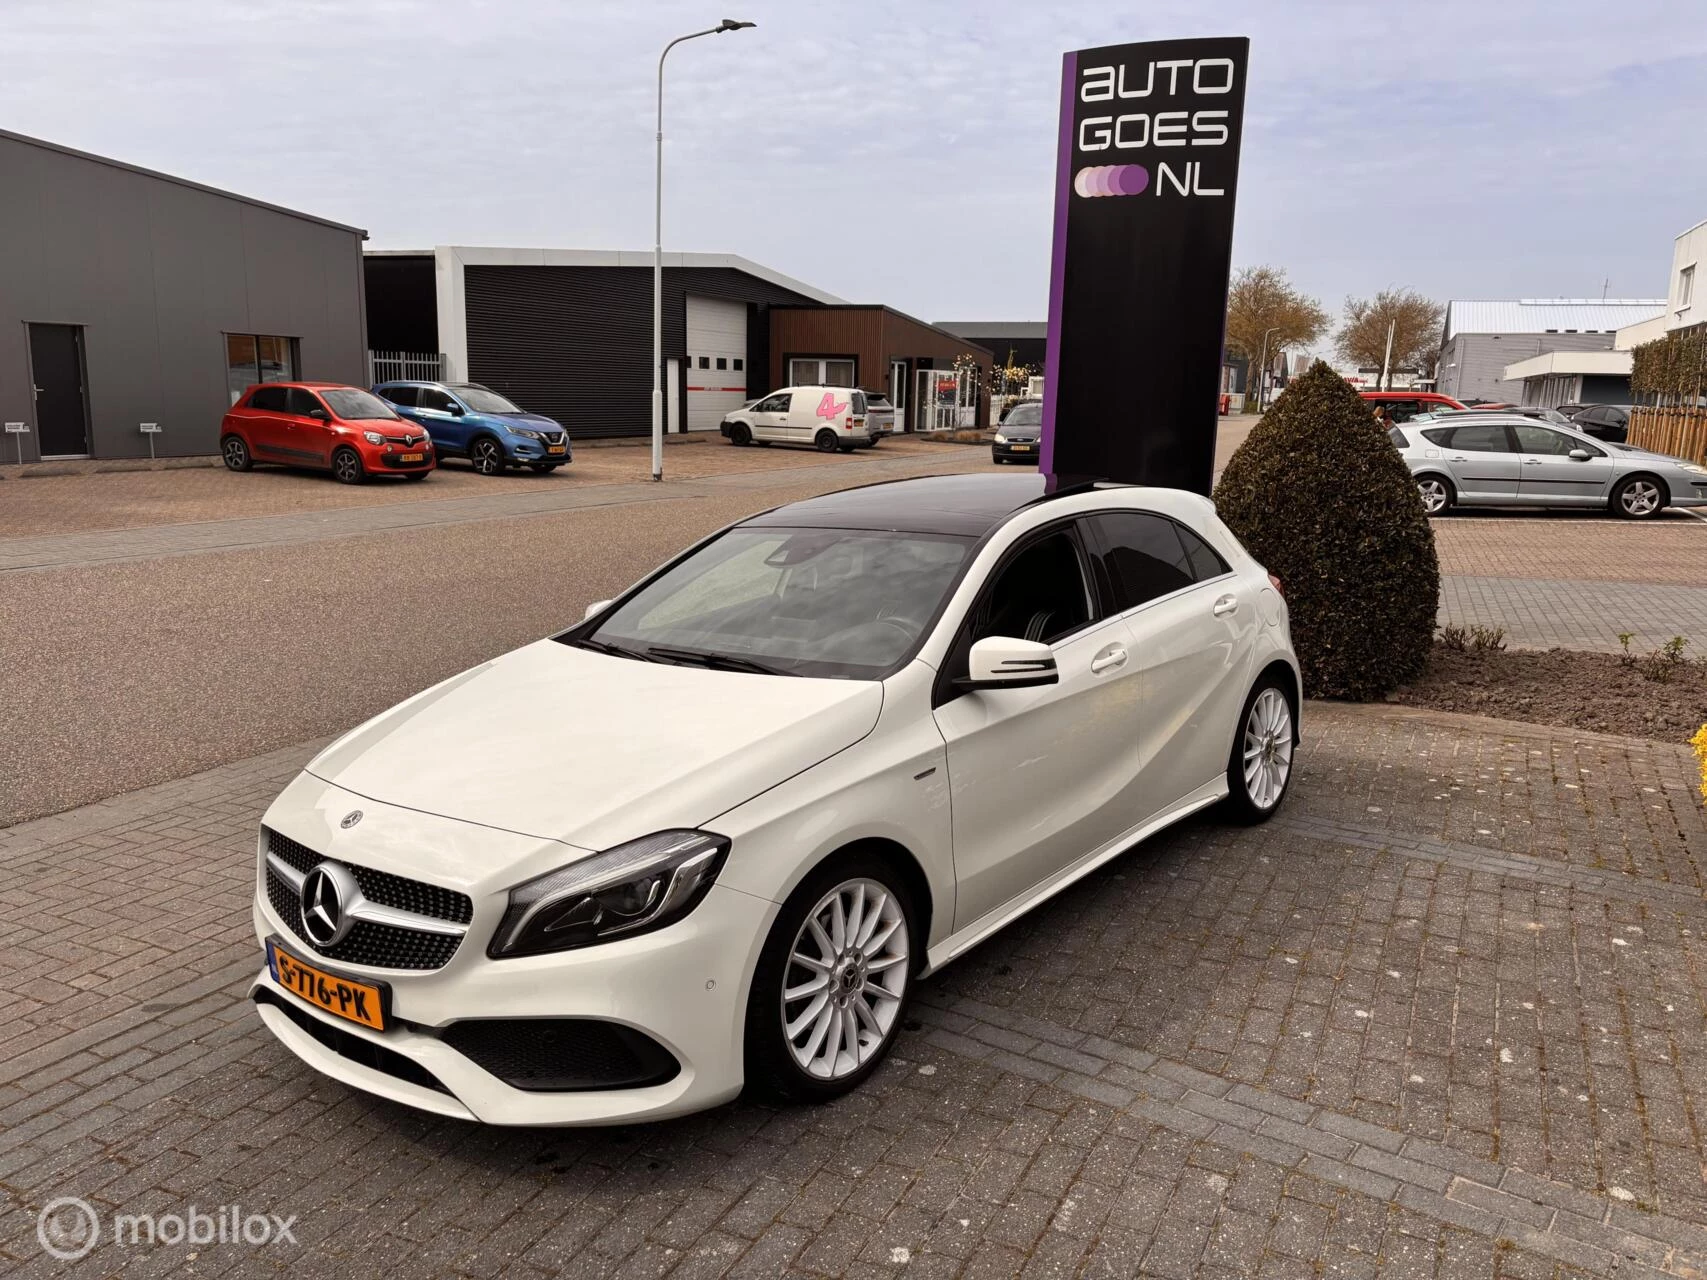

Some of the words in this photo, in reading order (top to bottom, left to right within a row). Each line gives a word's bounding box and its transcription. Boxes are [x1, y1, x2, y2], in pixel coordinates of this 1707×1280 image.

[1079, 110, 1229, 152] GOES
[1156, 161, 1225, 197] NL
[280, 956, 371, 1022] S-776-PK
